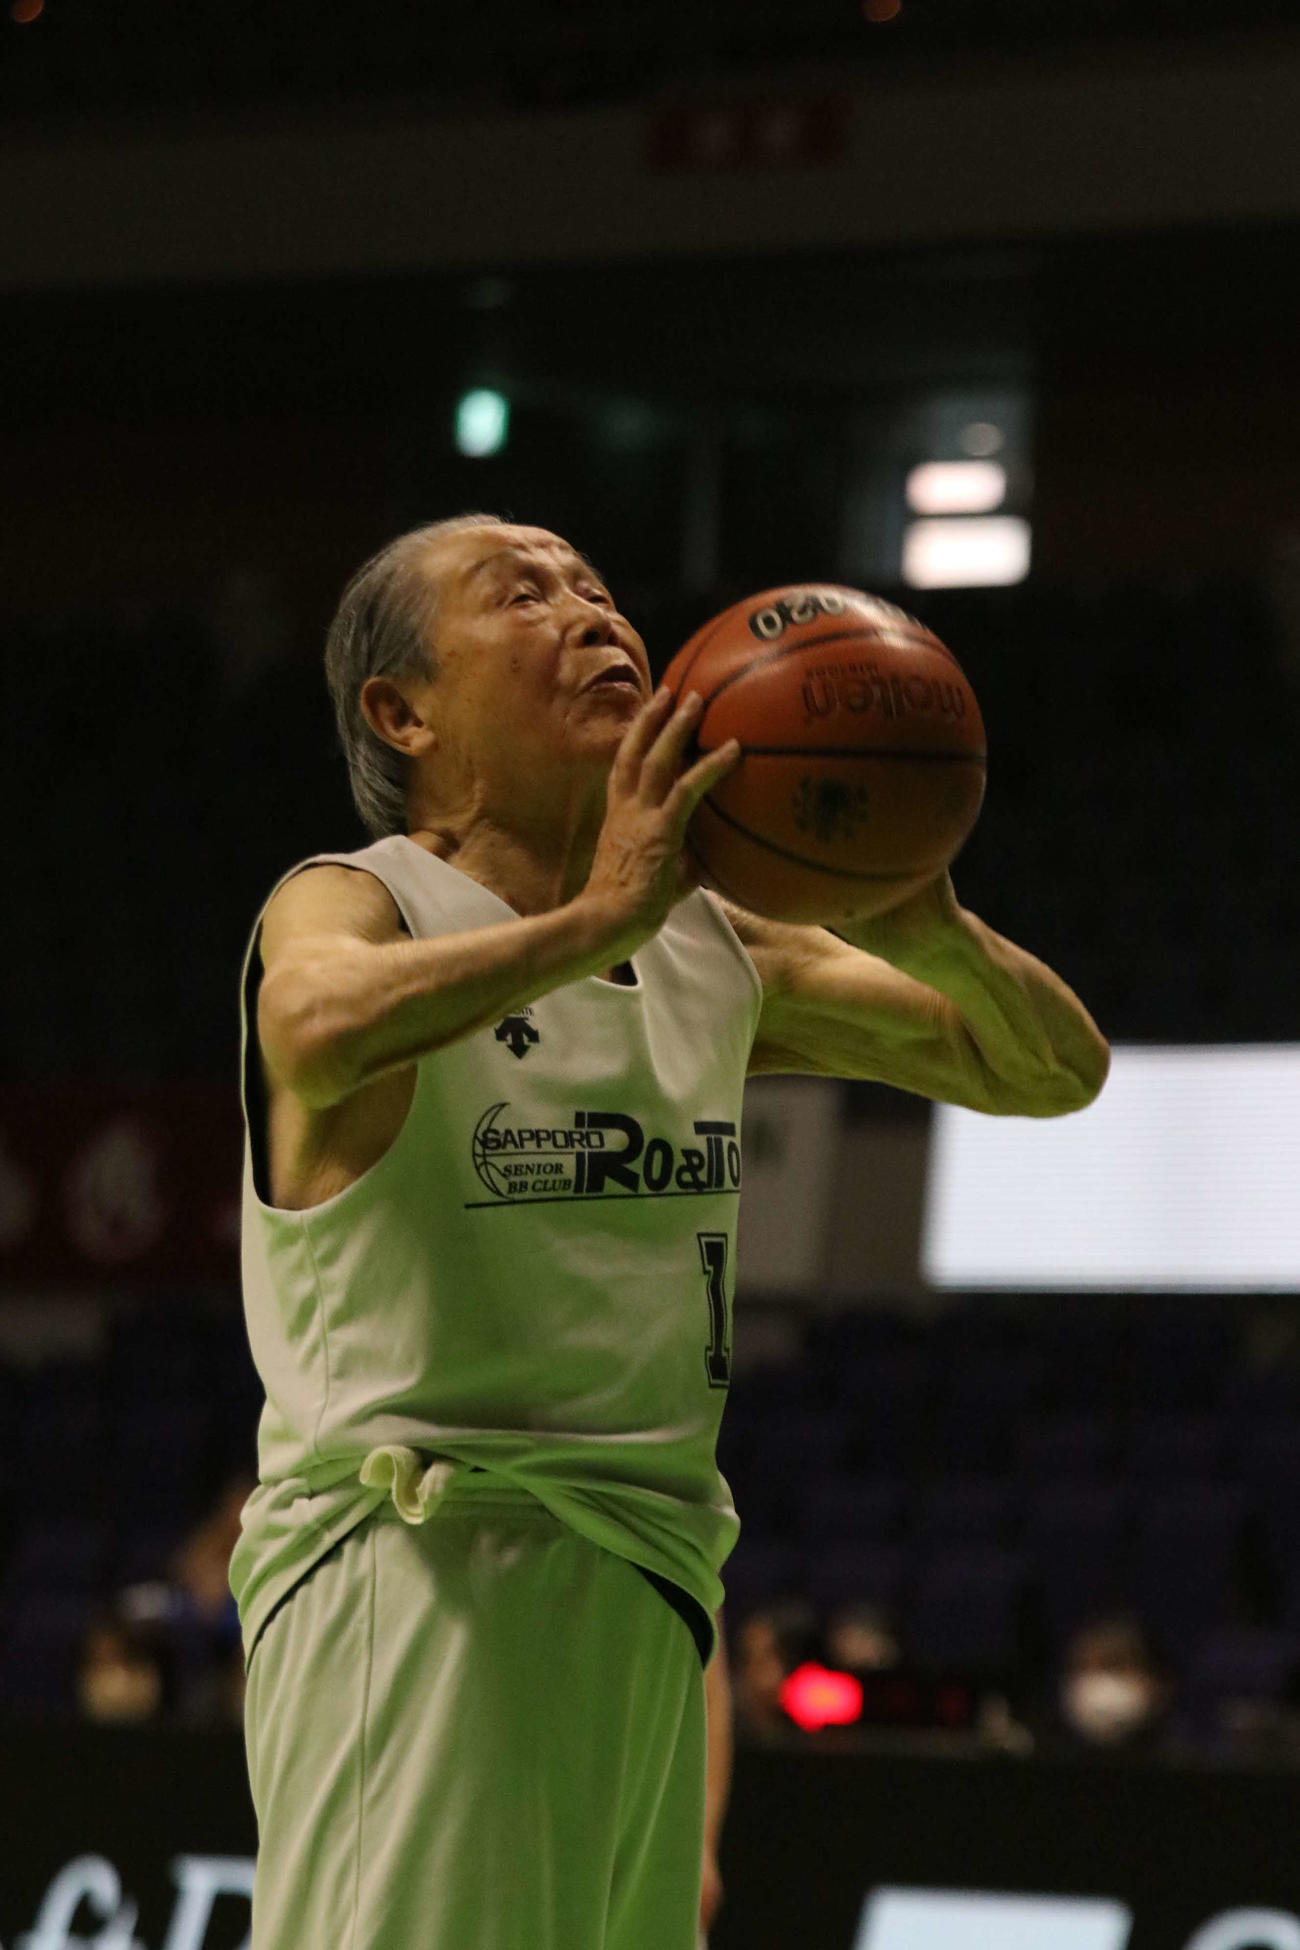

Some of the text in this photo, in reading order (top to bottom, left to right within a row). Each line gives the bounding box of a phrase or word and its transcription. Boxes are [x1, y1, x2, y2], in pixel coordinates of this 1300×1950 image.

[482, 1128, 605, 1150] SAPPORO
[503, 1162, 564, 1177] SENIOR
[507, 1179, 572, 1194] BB CLUB
[697, 1232, 731, 1389] 1
